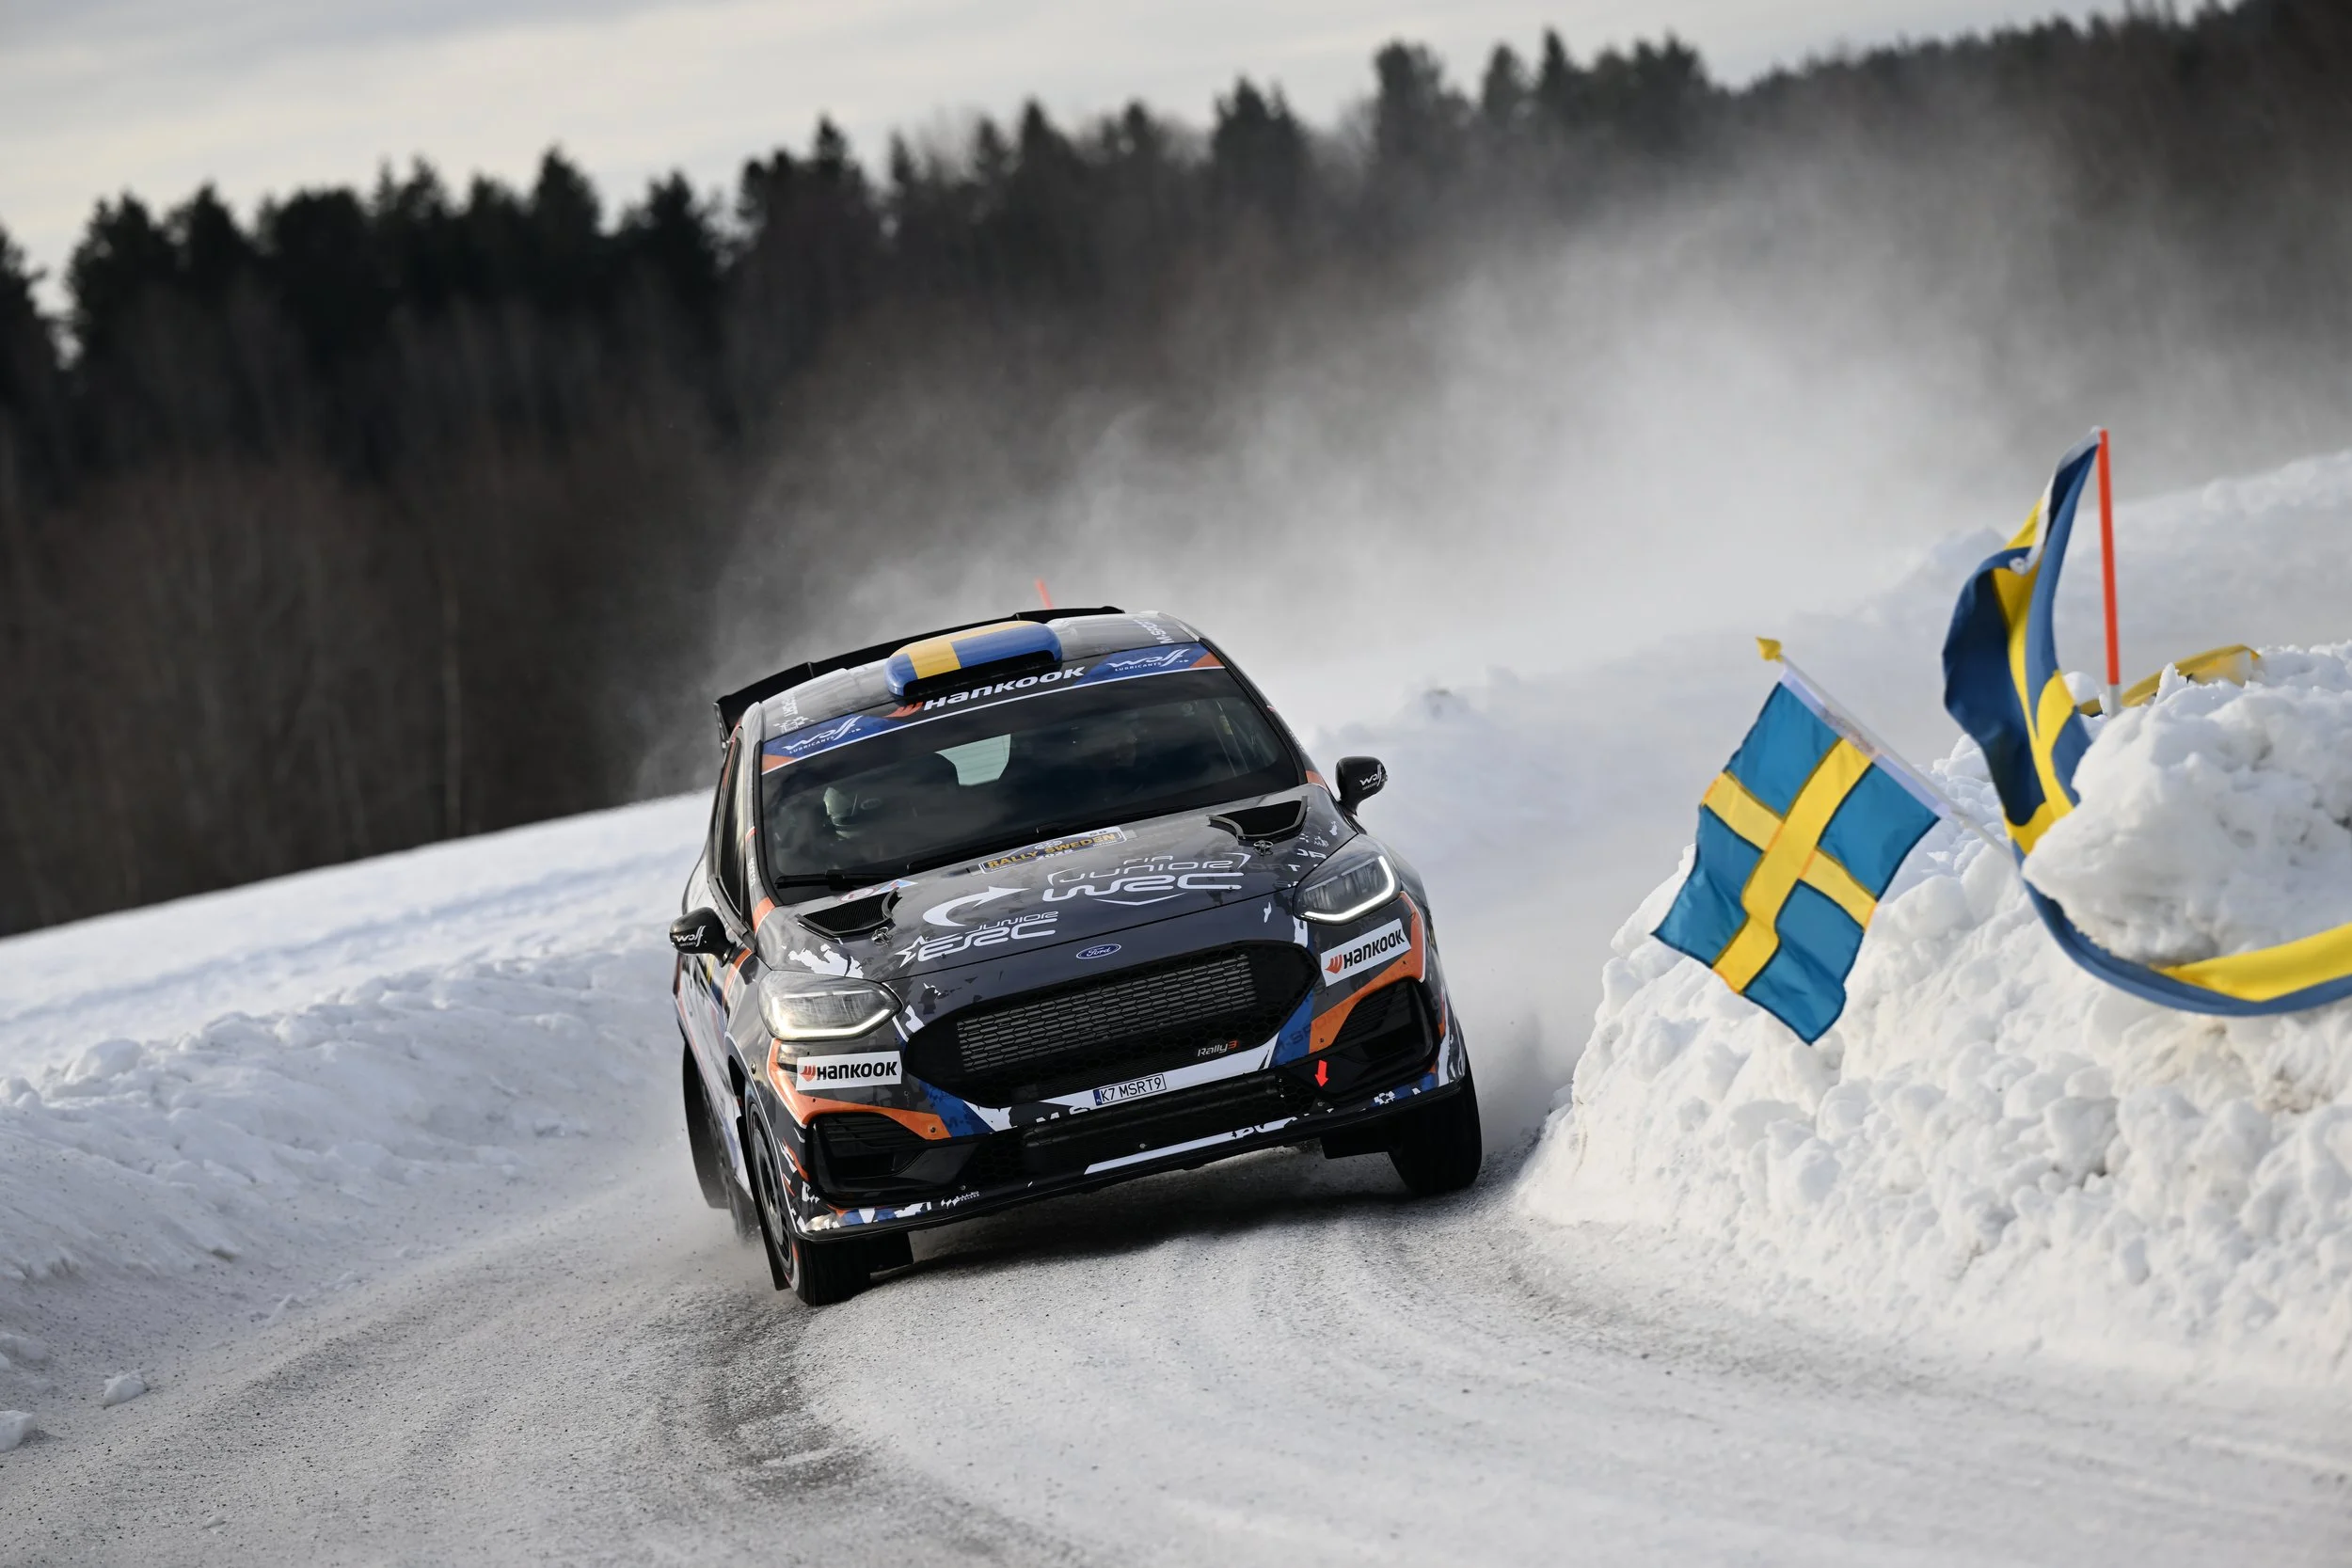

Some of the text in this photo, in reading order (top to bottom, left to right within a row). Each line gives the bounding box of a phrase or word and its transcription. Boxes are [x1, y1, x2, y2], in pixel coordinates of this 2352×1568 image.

[1114, 661, 1163, 672] LUBRICANTS
[788, 736, 835, 754] LUBRICANTS
[987, 850, 1040, 868] RALLY
[1044, 833, 1117, 853] SWEDEN
[1123, 855, 1174, 865] FIA
[1058, 860, 1234, 883] JUNIOR
[1041, 872, 1245, 902] WRC
[964, 911, 1059, 934] JUNIOR
[917, 917, 1058, 962] ERC
[1086, 946, 1111, 957] Ford
[1197, 1039, 1238, 1057] Rally3
[1100, 1077, 1162, 1102] K7 MSRT9
